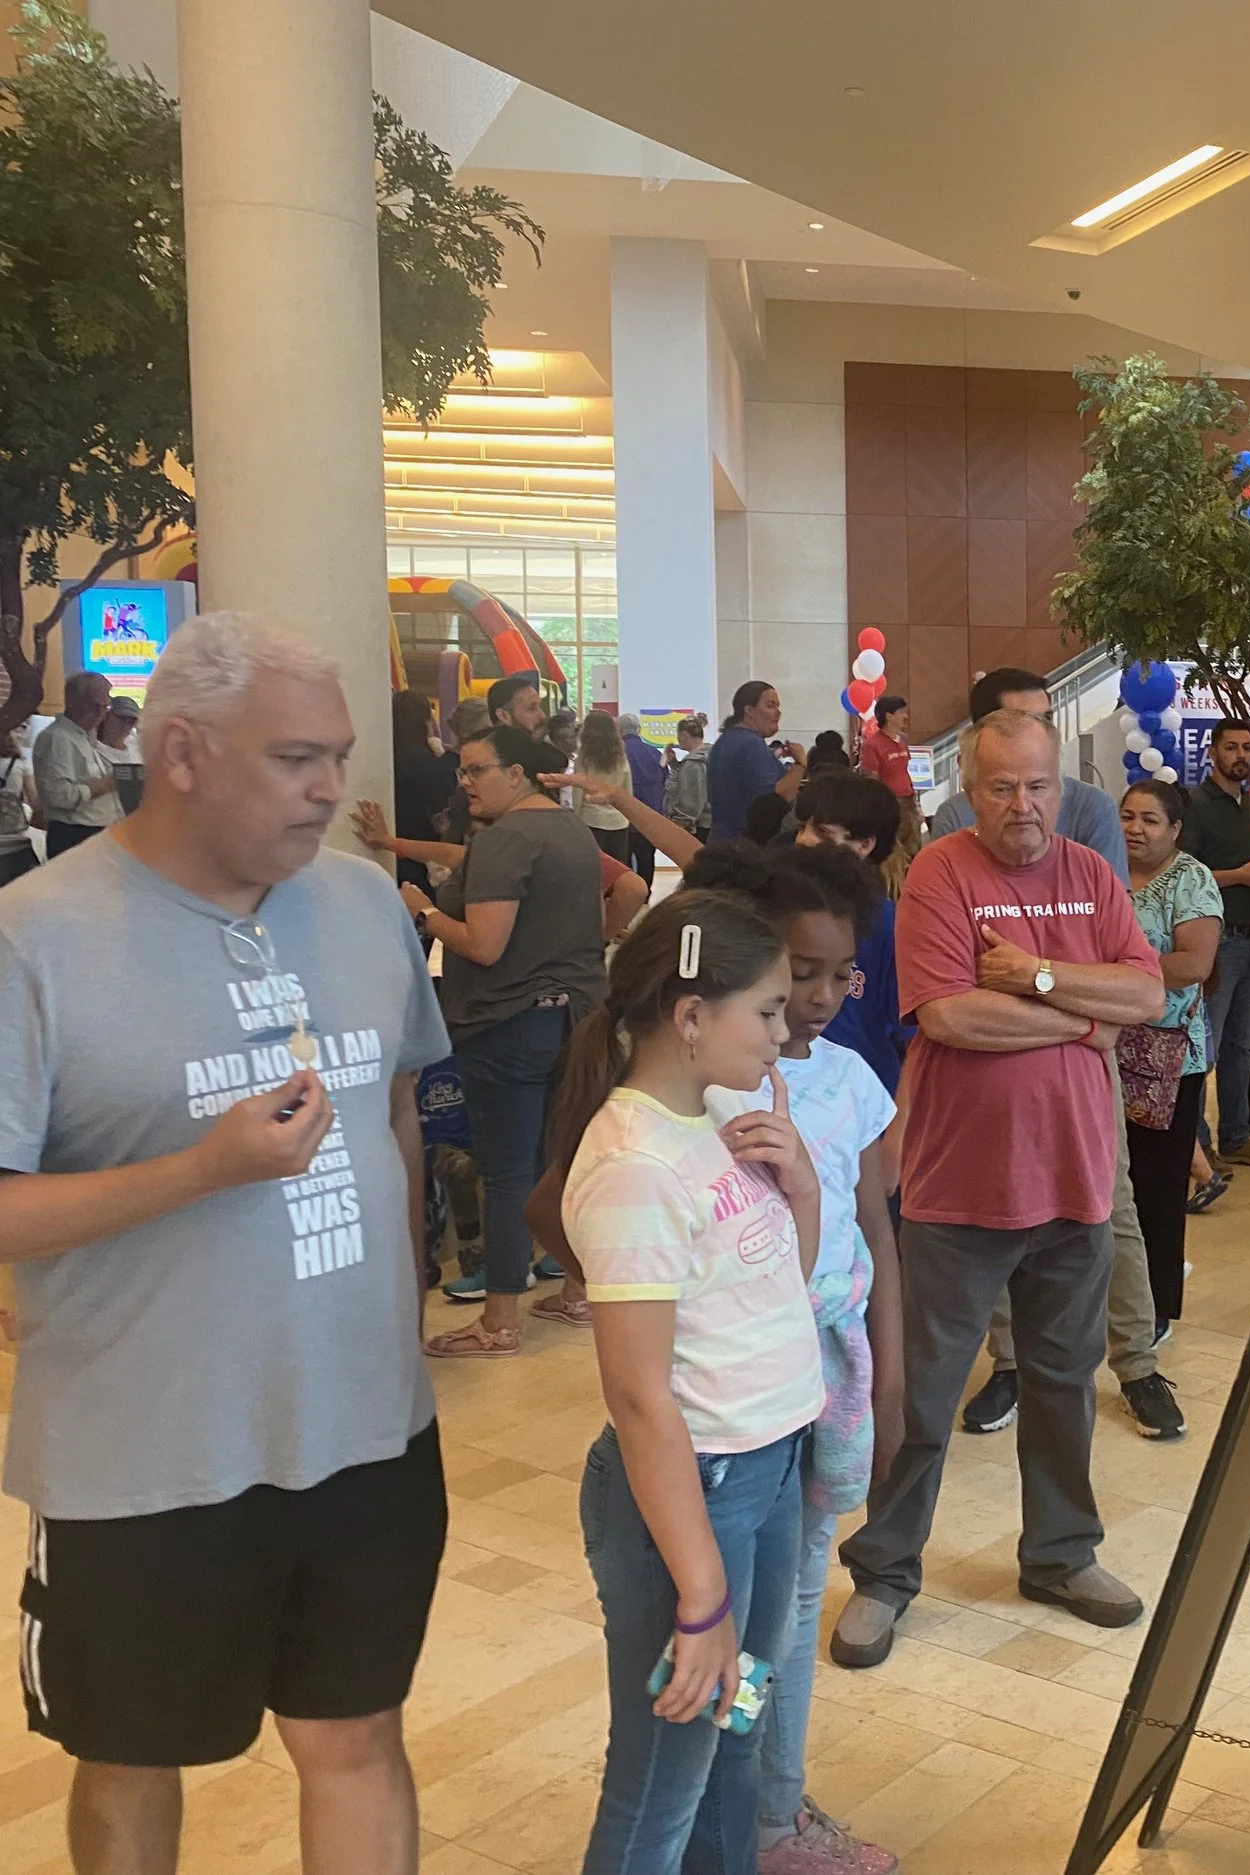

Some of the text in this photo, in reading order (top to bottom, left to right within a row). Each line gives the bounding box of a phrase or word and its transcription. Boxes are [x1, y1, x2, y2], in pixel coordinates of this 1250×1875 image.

[1181, 697, 1218, 710] WEEKS
[971, 904, 1021, 920] PRING
[227, 973, 305, 1010] I WAS
[238, 1009, 276, 1031] ONE
[185, 1053, 248, 1095] AND
[324, 1035, 340, 1067] I
[342, 1029, 382, 1064] AM
[319, 1062, 381, 1092] FFERENT
[309, 1150, 350, 1175] PENED
[300, 1169, 356, 1196] BETWEEN
[287, 1188, 361, 1236] WAS
[292, 1223, 364, 1280] HIM
